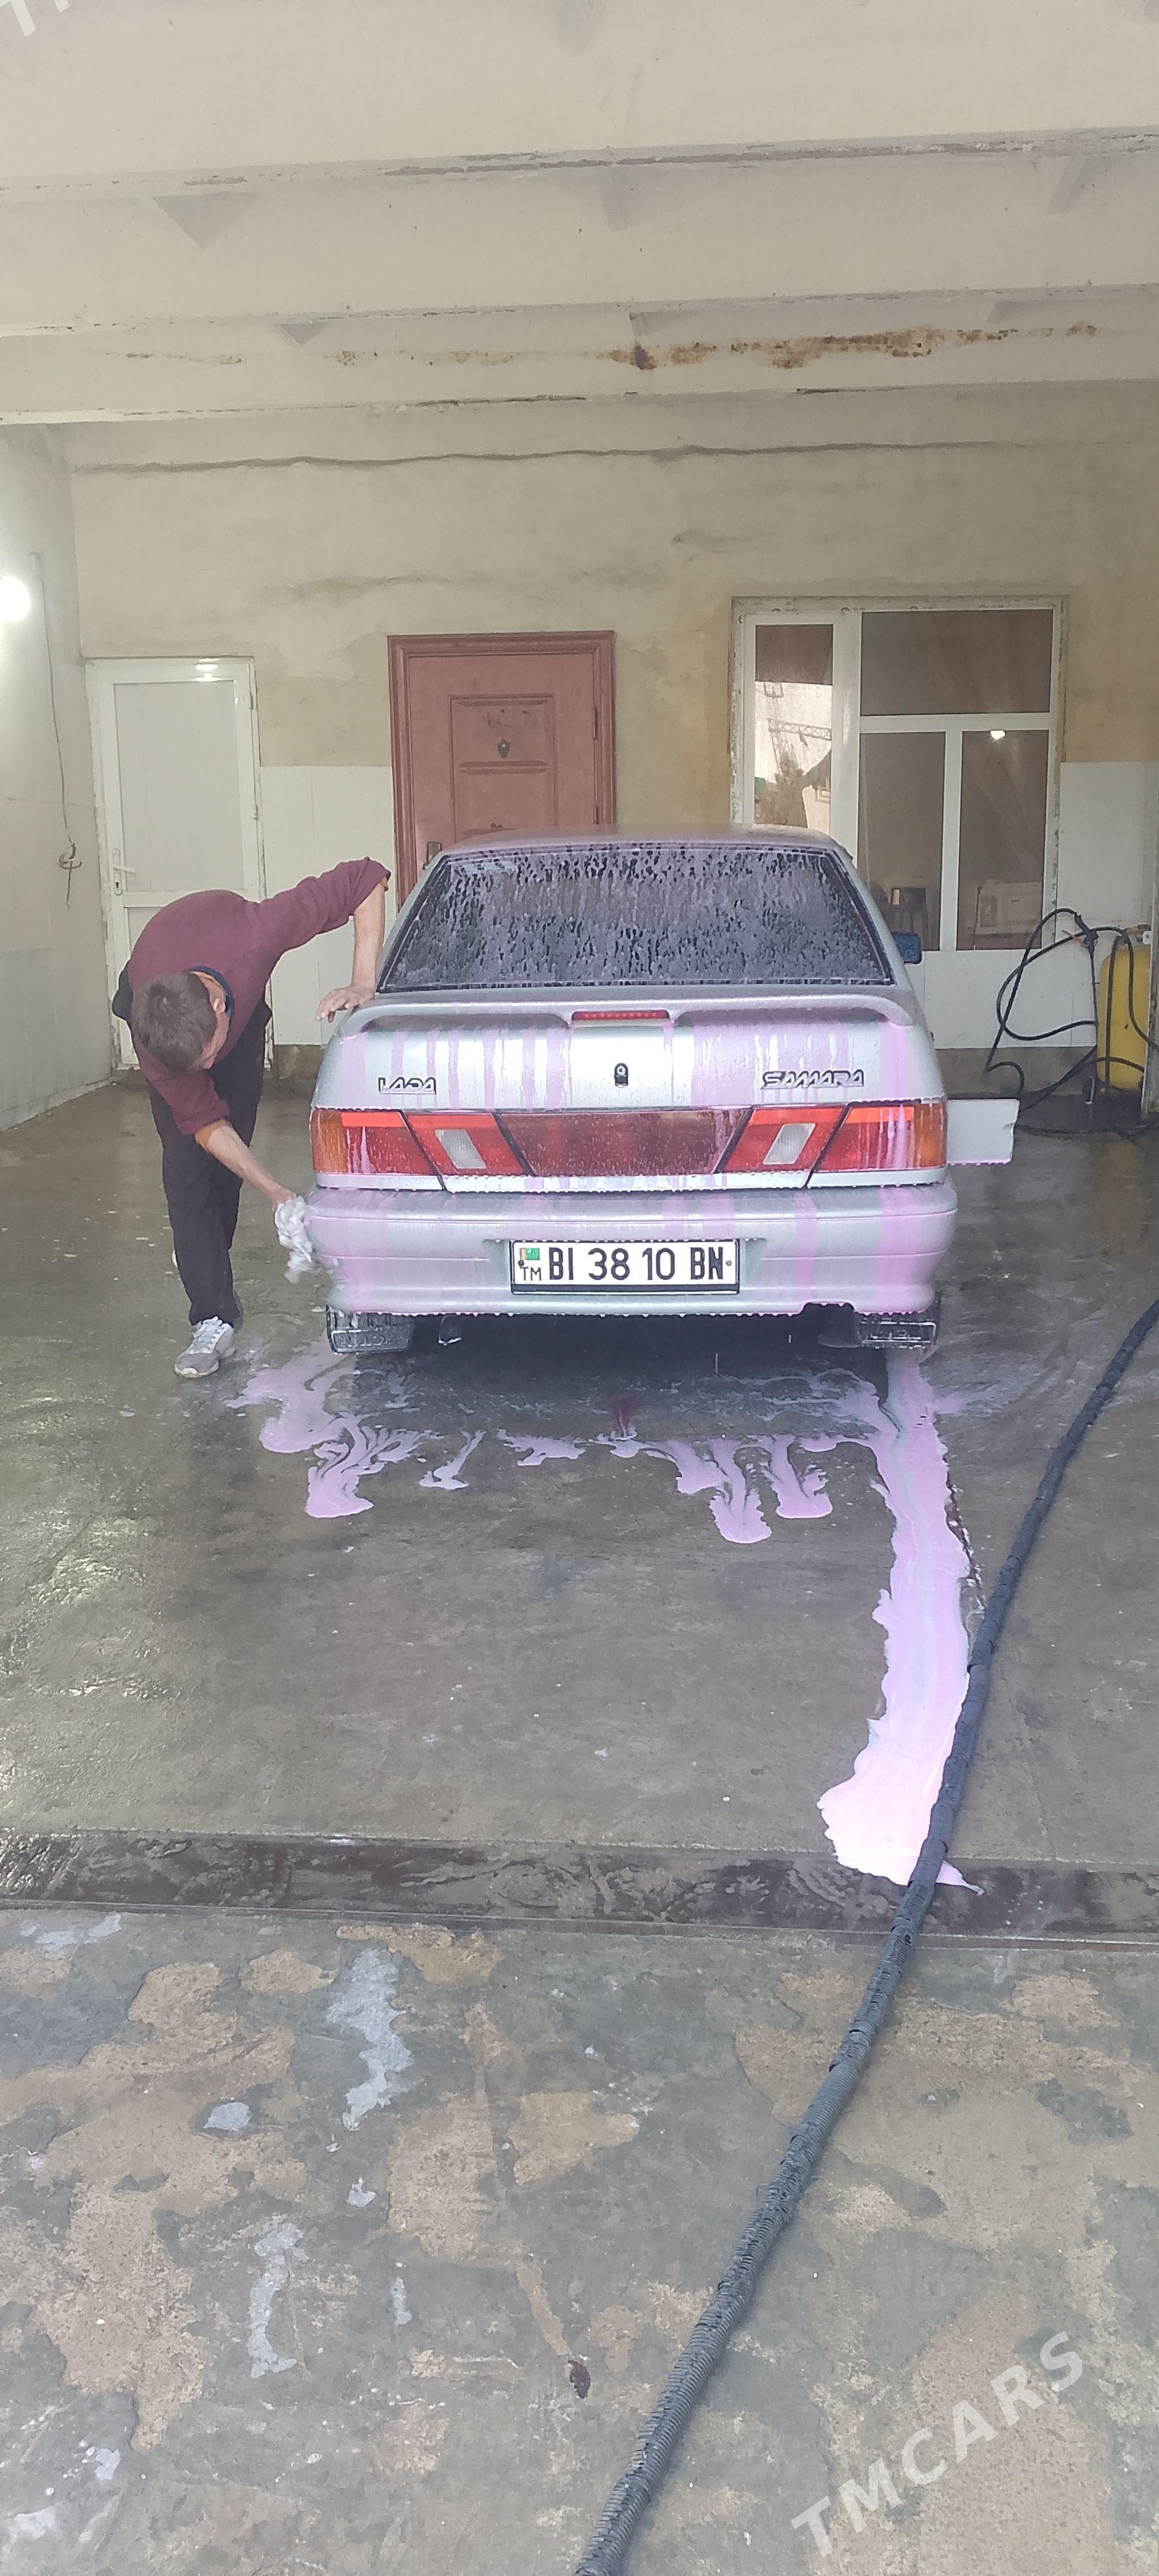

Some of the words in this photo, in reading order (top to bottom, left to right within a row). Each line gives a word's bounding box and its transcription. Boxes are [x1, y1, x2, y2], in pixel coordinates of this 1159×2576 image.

[378, 1076, 437, 1095] LADA
[760, 1069, 864, 1090] SAMARA
[519, 1266, 542, 1281] TM
[548, 1247, 575, 1281] BI
[588, 1247, 630, 1281] 38
[641, 1247, 675, 1281] 10
[690, 1246, 724, 1280] BN
